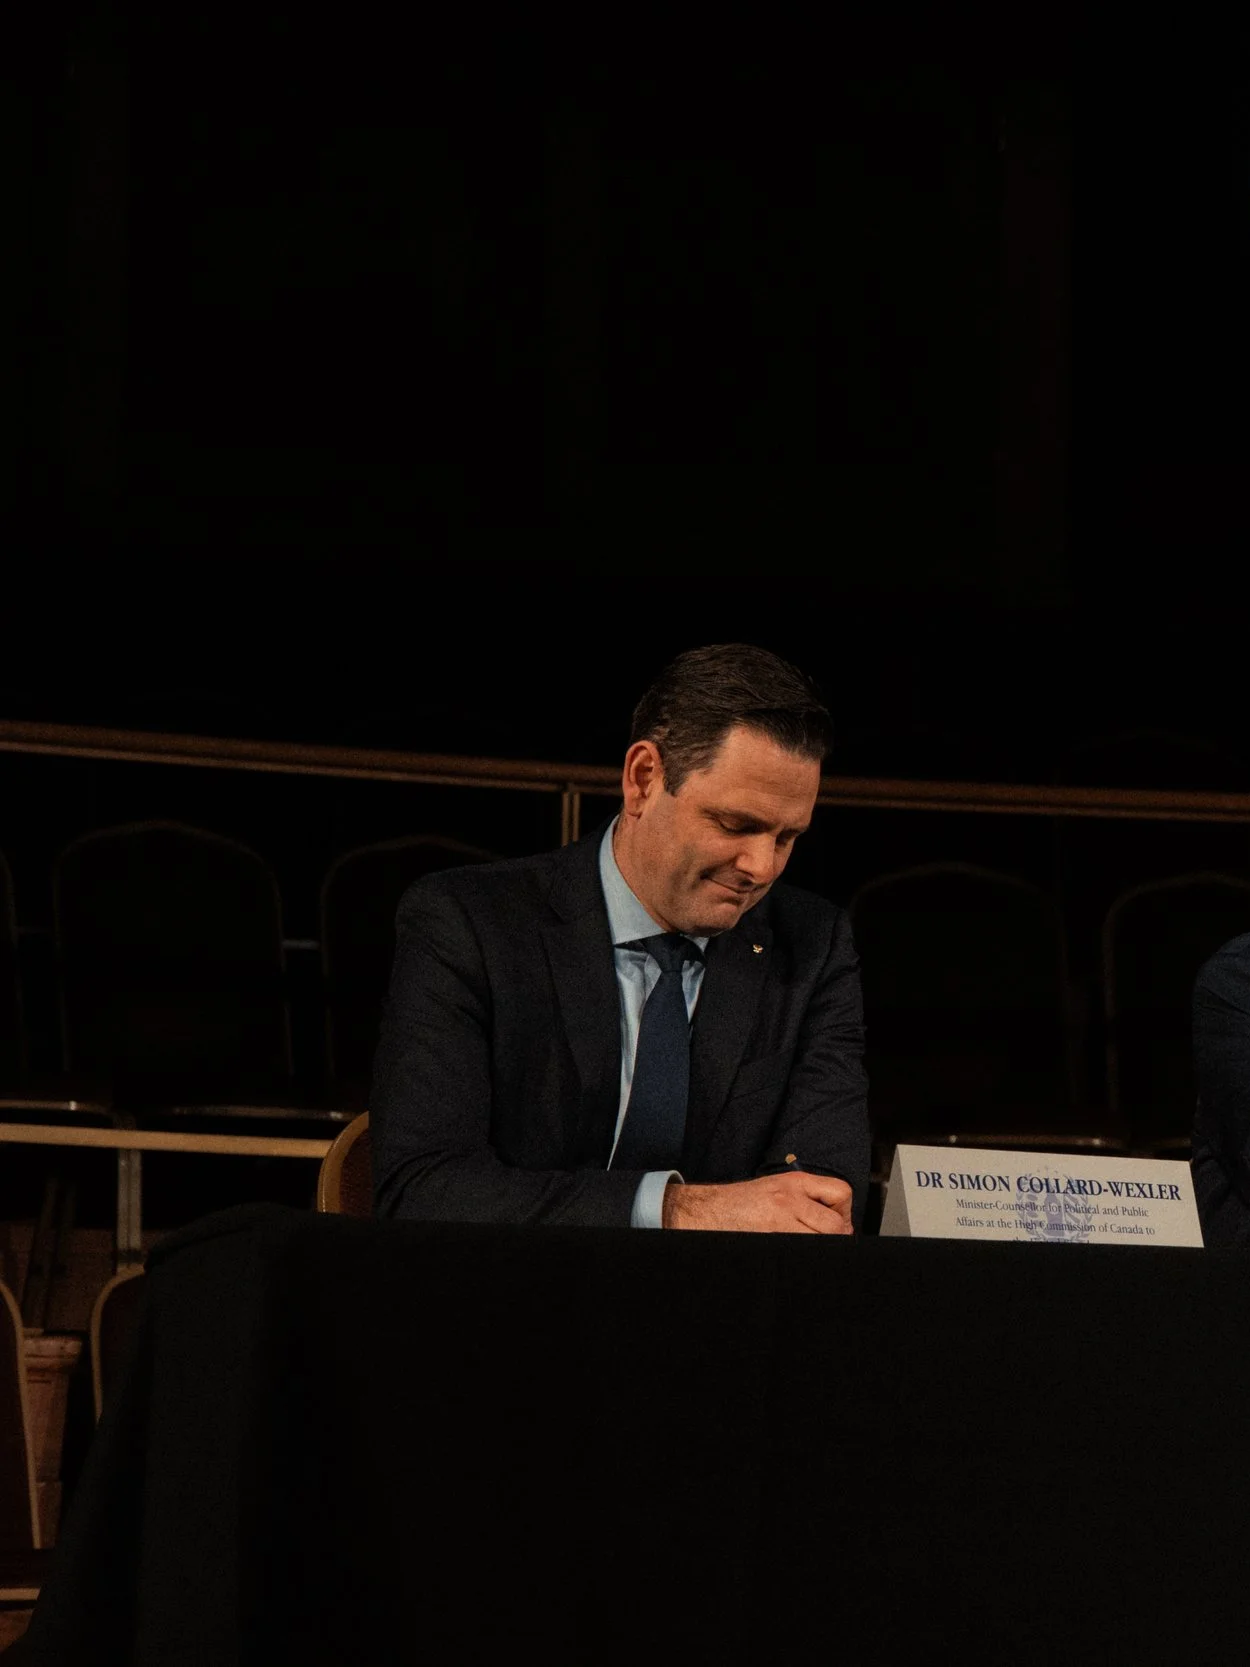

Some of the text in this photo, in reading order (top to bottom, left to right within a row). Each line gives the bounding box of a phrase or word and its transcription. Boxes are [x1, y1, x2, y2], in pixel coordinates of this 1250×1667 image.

[915, 1170, 1182, 1201] DR SIMON COLLARD-WEXLER
[956, 1199, 1149, 1217] Minister-Counsellor for Political and Public
[955, 1217, 1156, 1236] Affairs at the High Commission of Canada to
